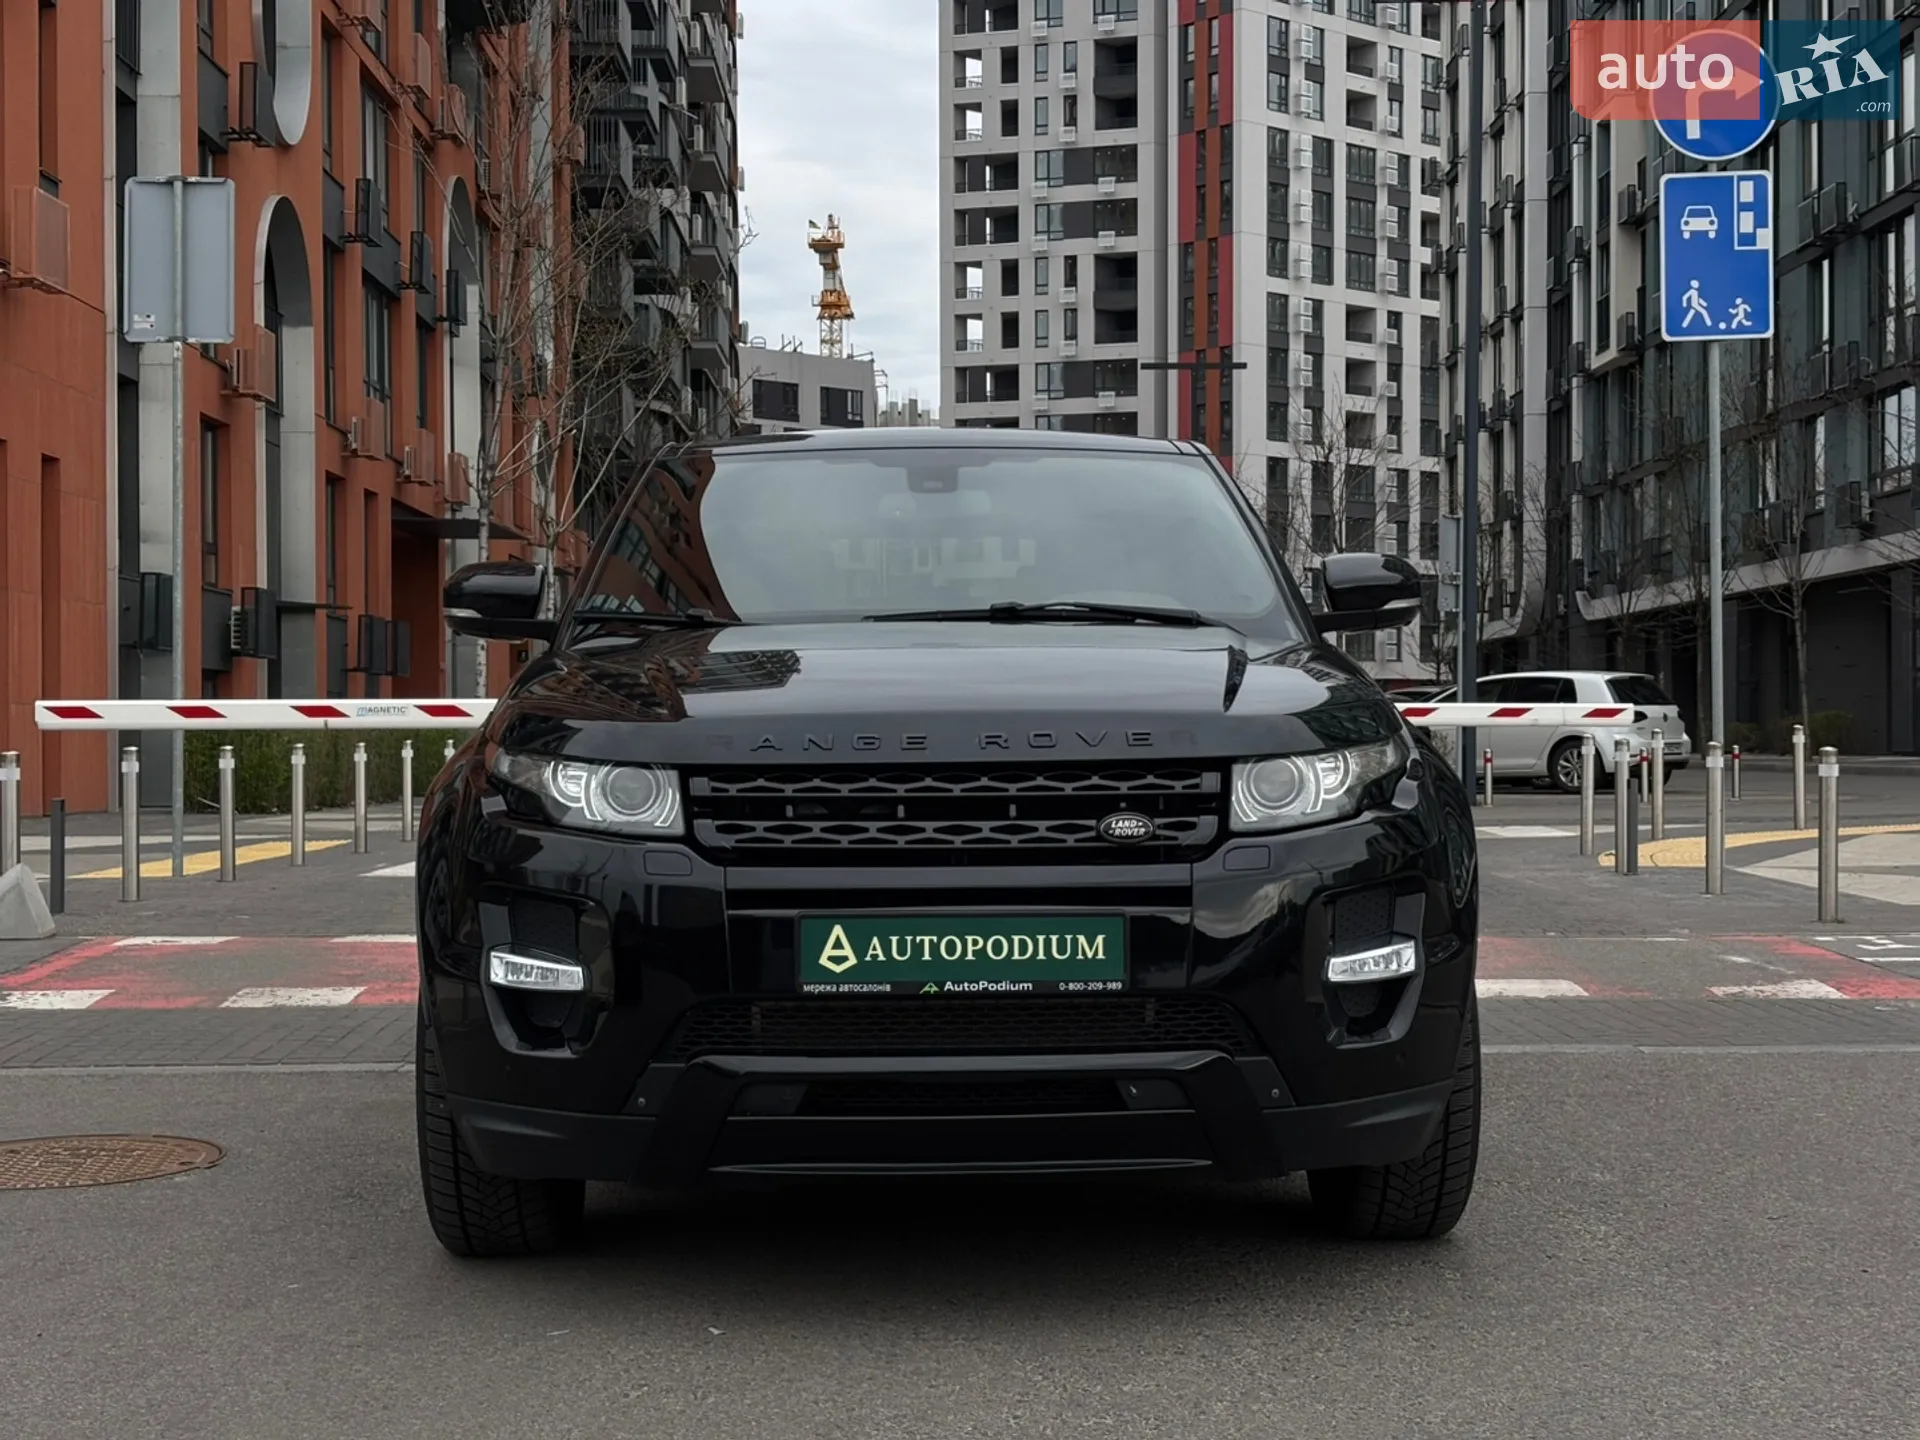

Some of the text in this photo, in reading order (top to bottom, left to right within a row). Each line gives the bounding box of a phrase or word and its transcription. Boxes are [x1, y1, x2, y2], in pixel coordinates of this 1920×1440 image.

[864, 934, 1107, 961] AUTOPODIUM
[803, 982, 892, 994] мережа автосалонів
[943, 980, 1033, 992] AutoPodium
[1059, 981, 1123, 991] 0-800-209-989
